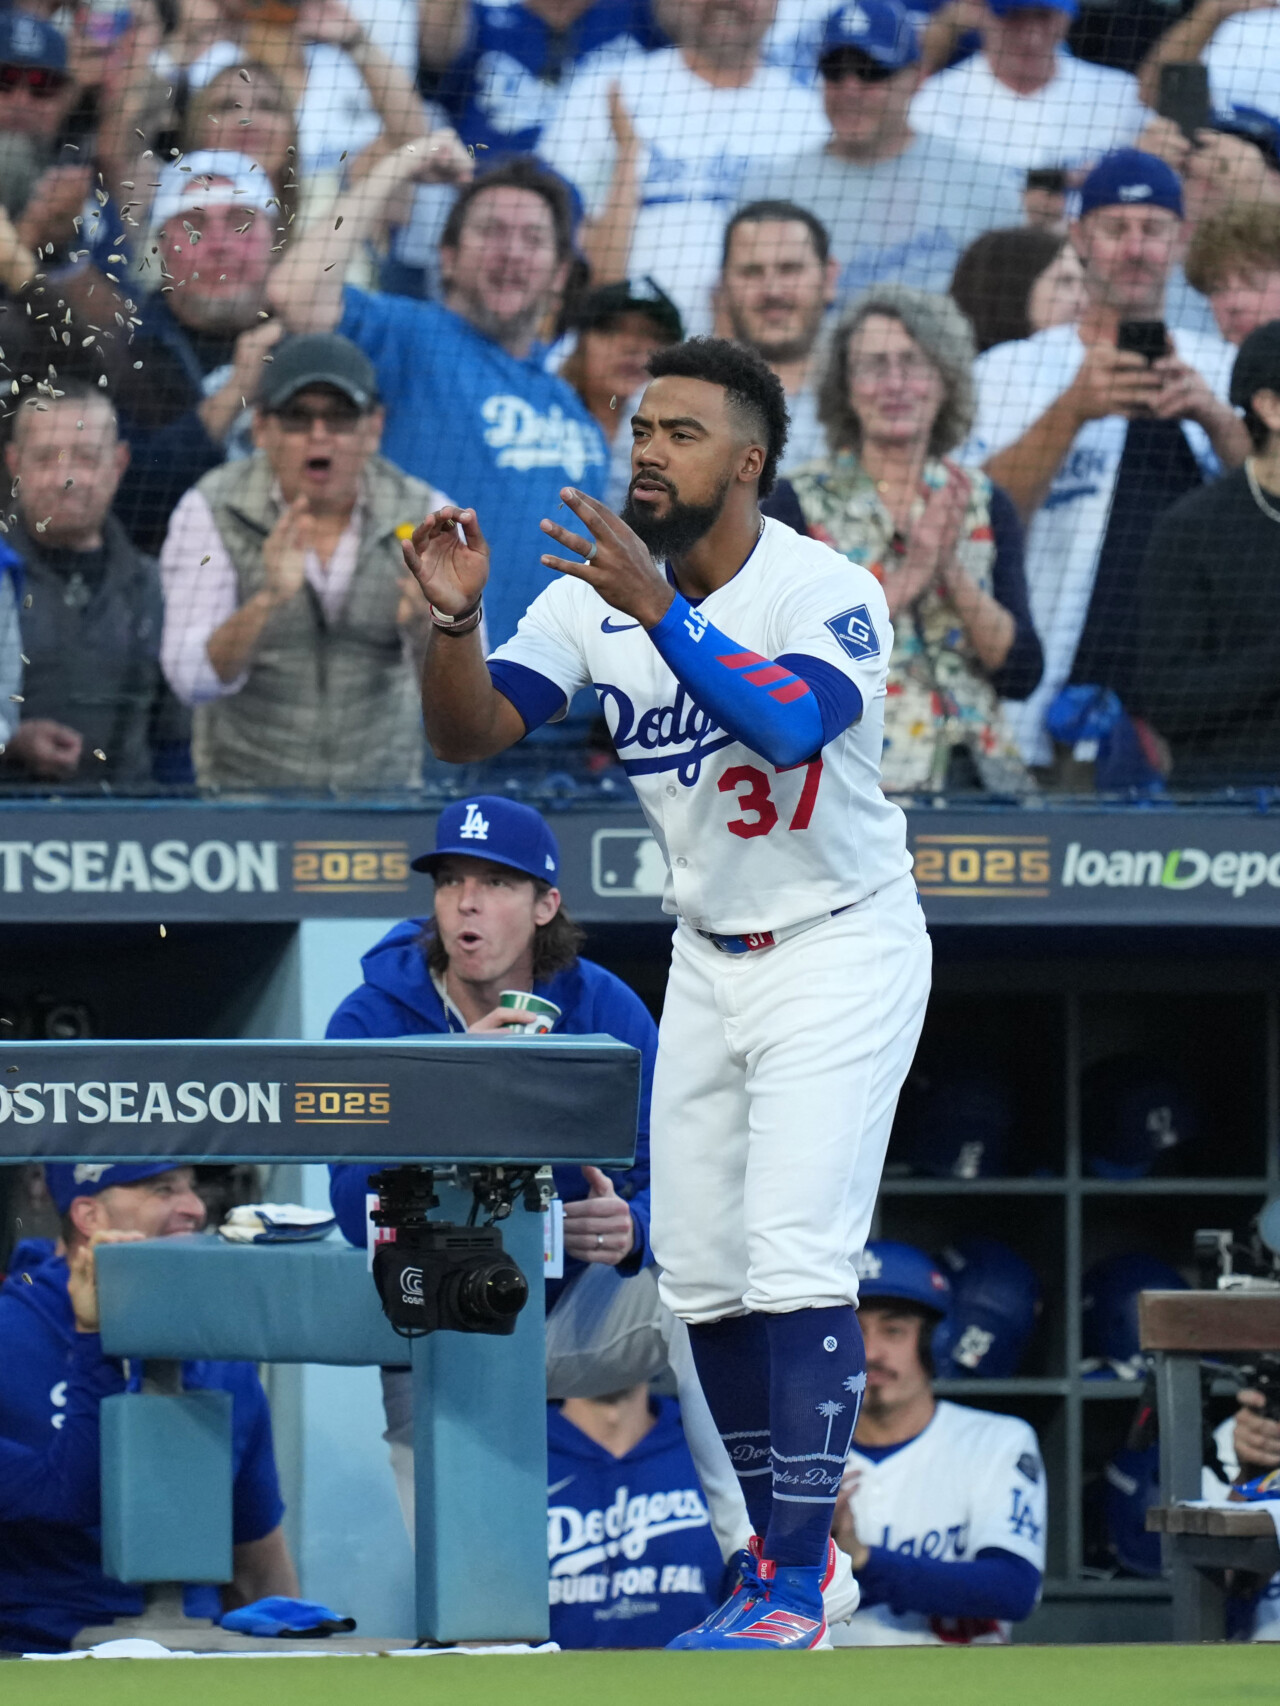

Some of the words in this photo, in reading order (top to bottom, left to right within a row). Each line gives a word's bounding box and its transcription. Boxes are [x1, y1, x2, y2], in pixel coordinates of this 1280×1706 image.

[593, 682, 723, 787] Dodg
[717, 763, 824, 840] 37
[460, 804, 489, 840] LA
[292, 852, 409, 881] 2025
[914, 849, 1050, 883] 2025
[294, 1091, 390, 1114] 2025
[1010, 1488, 1040, 1544] LA
[612, 1565, 657, 1599] FOR
[660, 1564, 705, 1594] FAL
